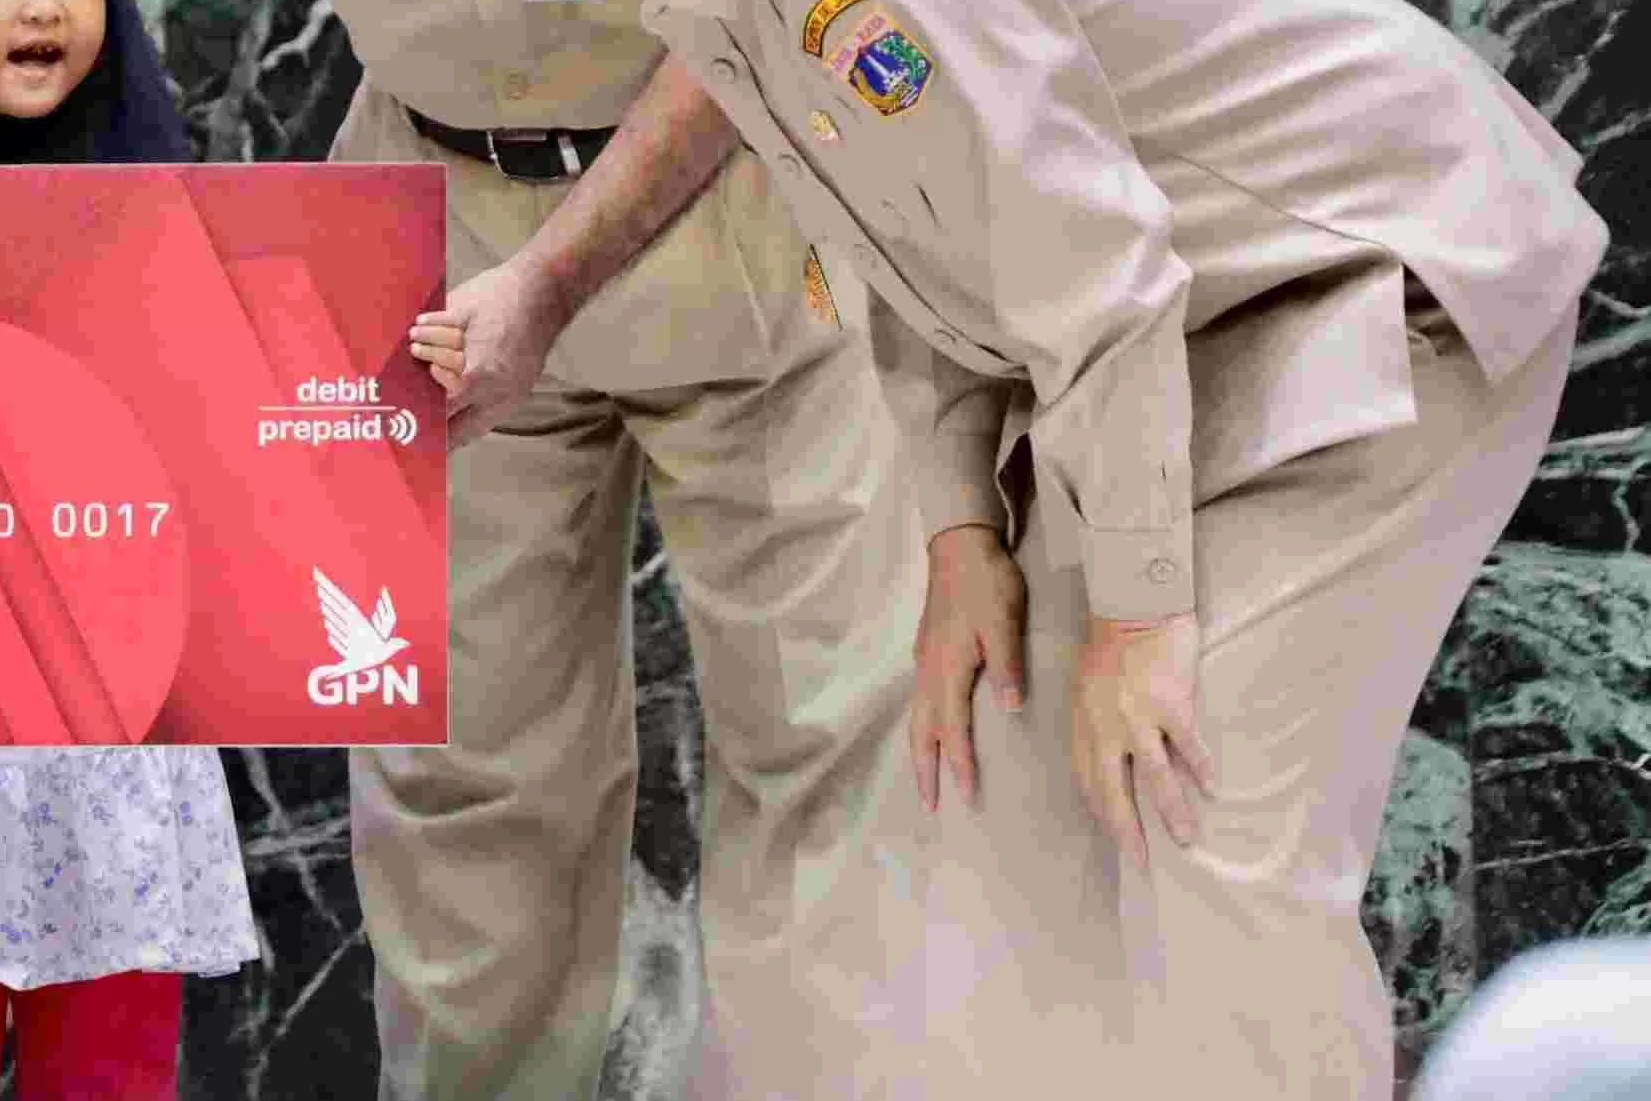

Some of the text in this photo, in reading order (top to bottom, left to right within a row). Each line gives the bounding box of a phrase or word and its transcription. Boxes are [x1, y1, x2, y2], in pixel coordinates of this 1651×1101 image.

[296, 375, 382, 403] debit
[257, 413, 383, 447] prepaid
[52, 502, 170, 538] 0017
[307, 663, 419, 706] GPN
